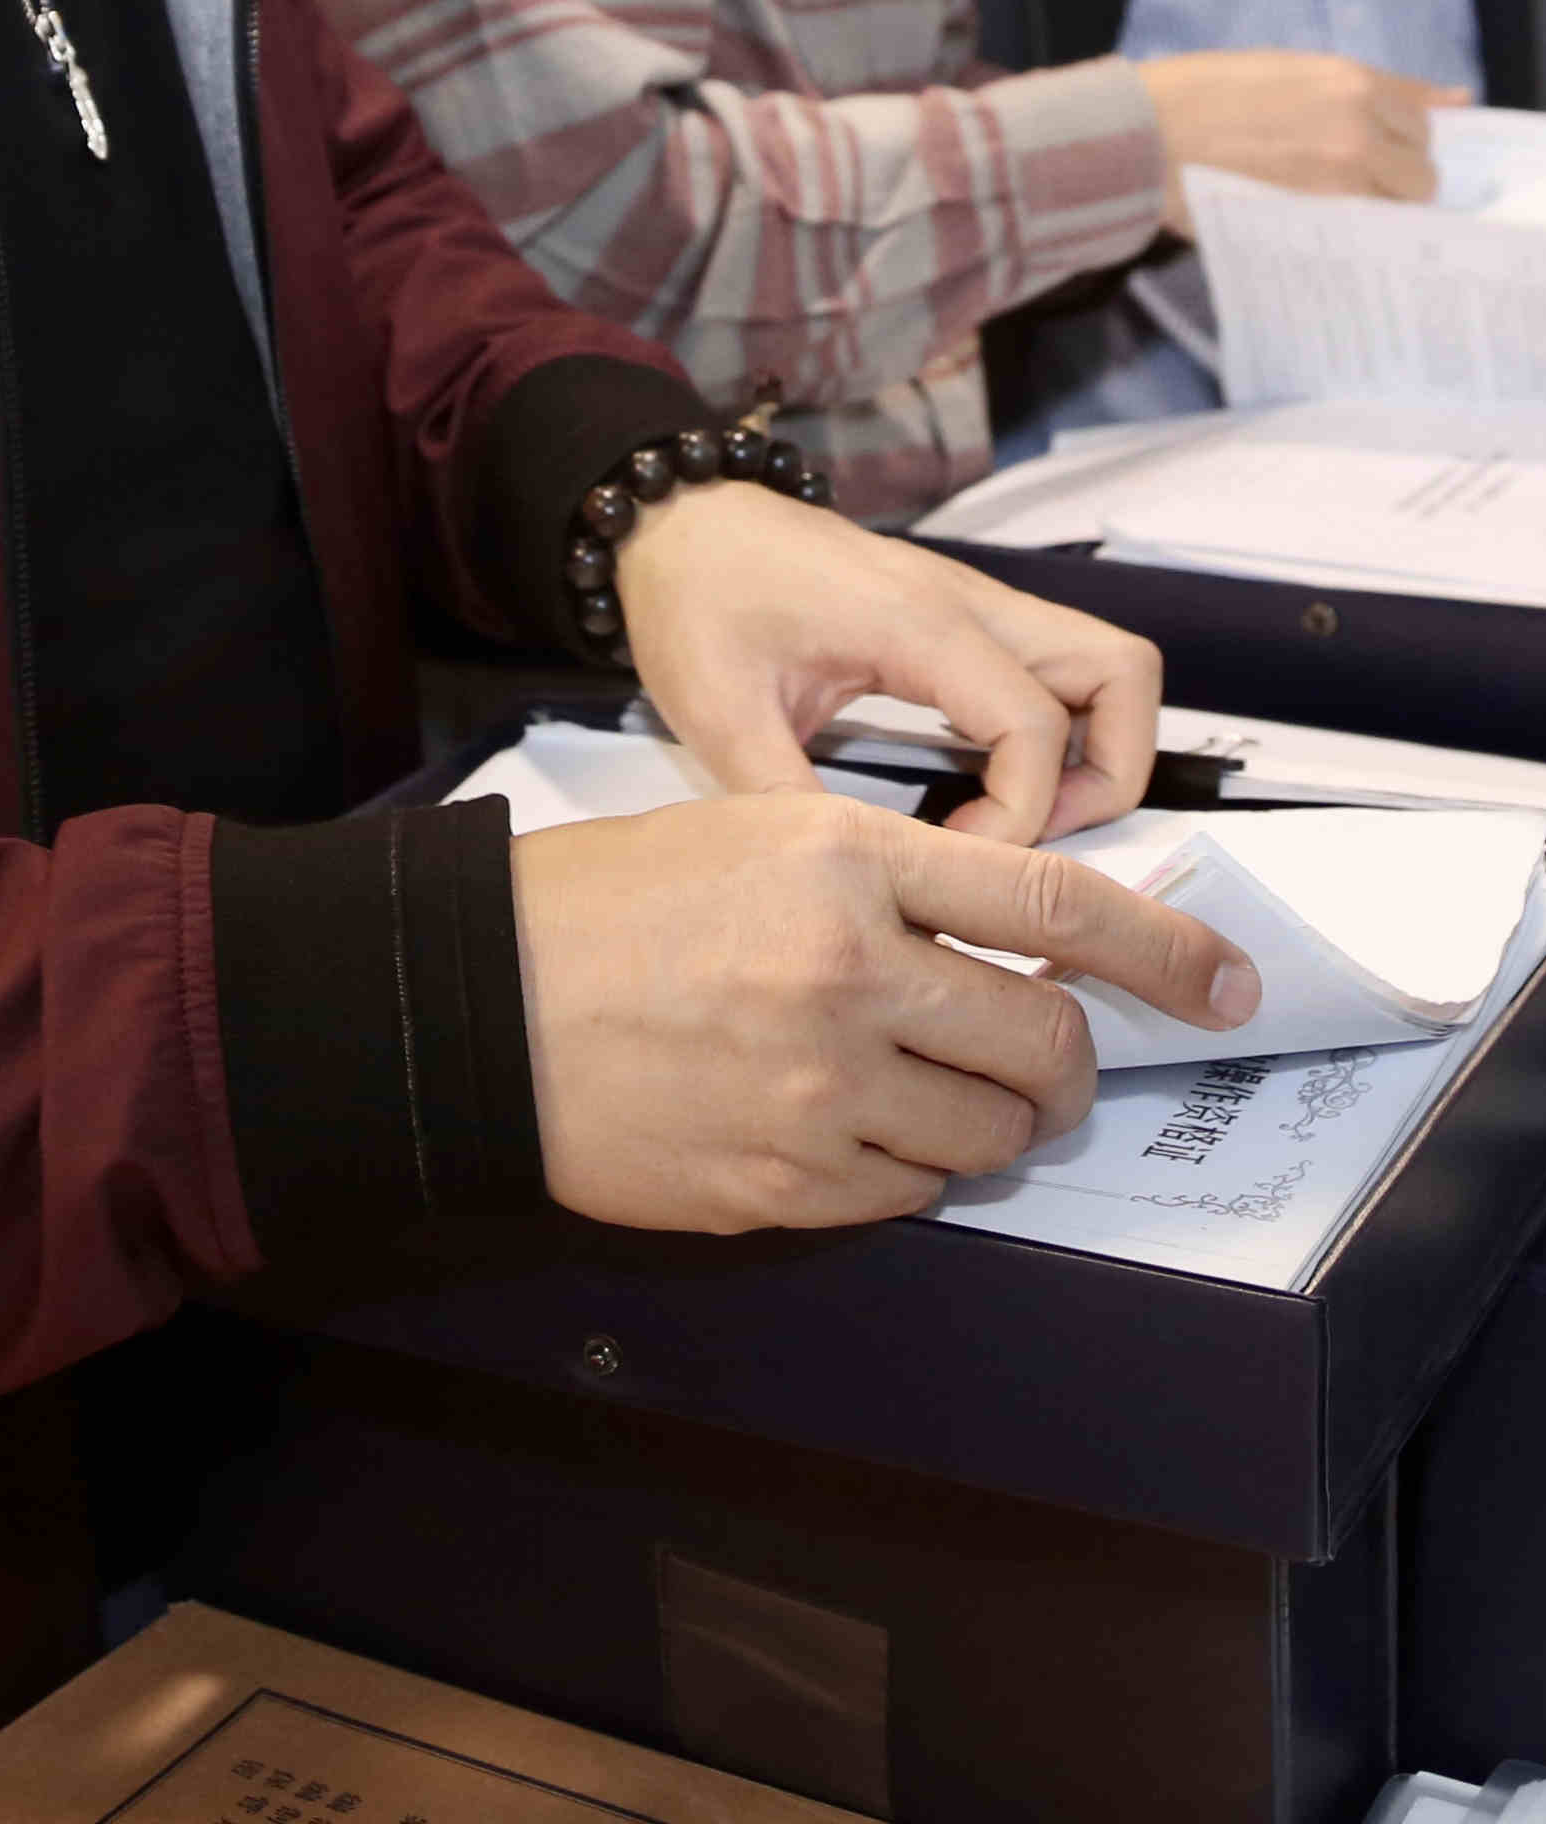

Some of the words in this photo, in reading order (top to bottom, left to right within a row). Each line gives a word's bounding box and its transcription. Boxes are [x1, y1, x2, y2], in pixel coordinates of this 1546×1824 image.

[1140, 1053, 1279, 1165] 操作资格证
